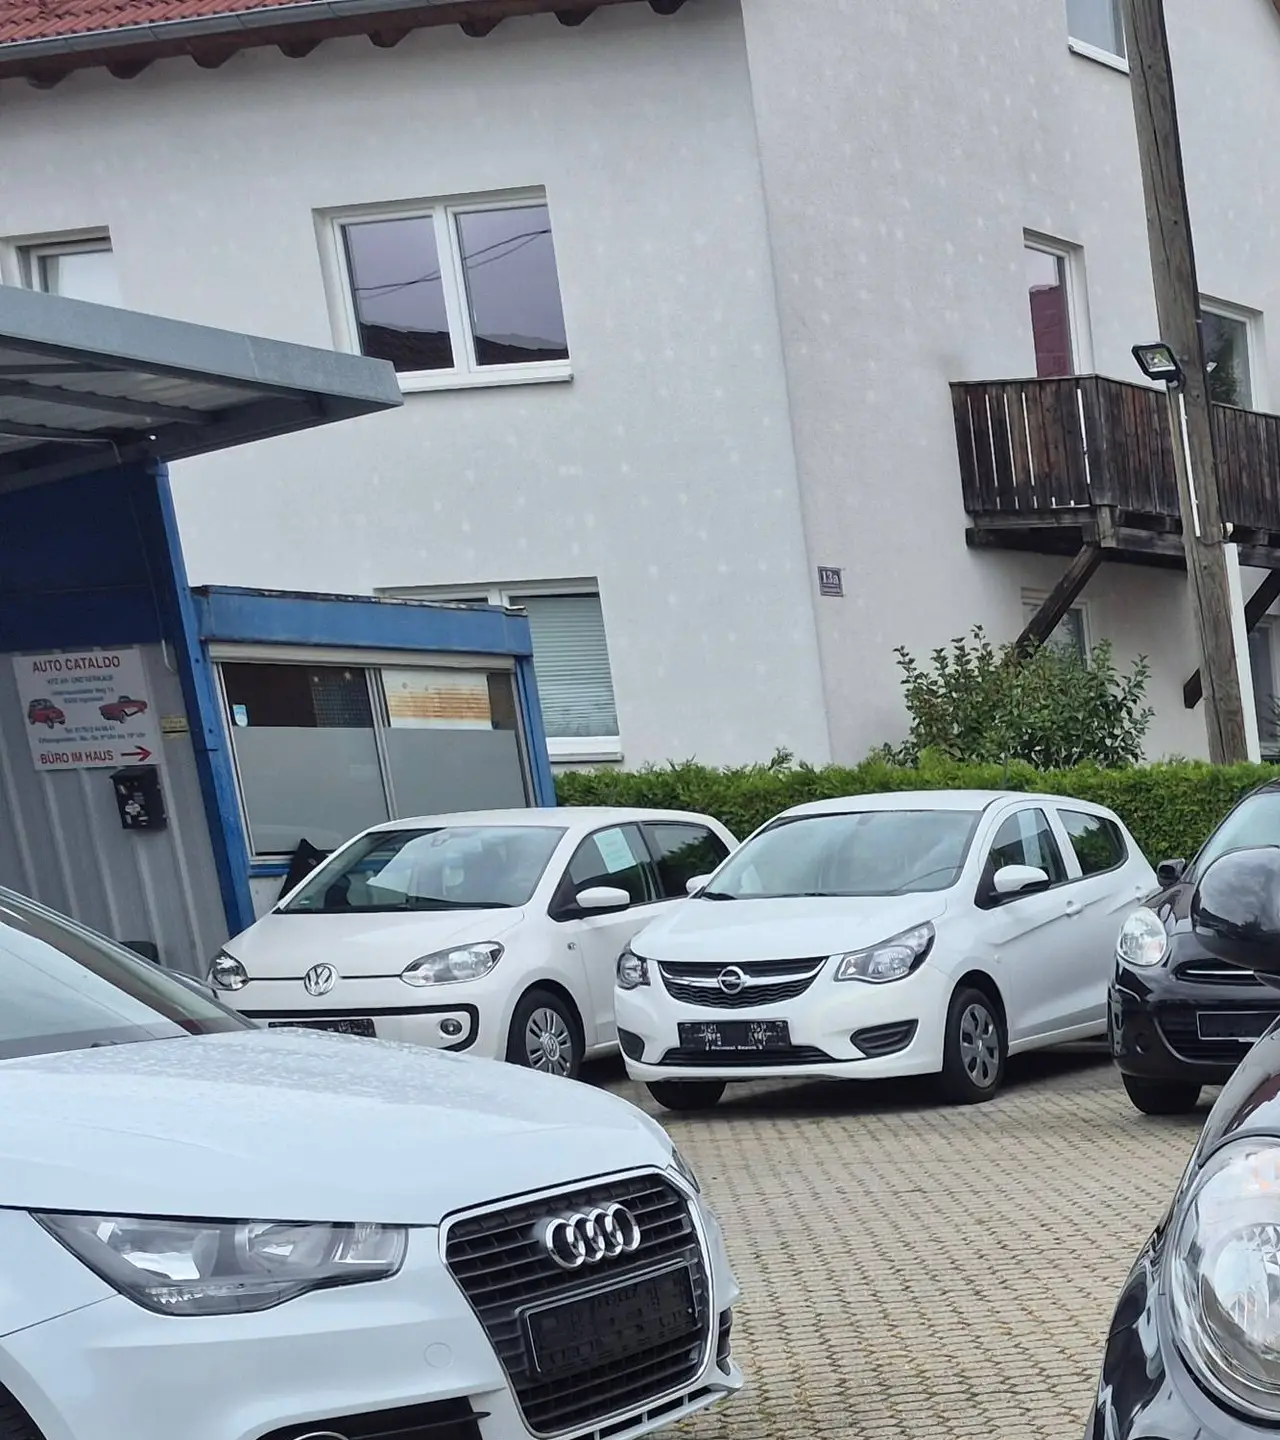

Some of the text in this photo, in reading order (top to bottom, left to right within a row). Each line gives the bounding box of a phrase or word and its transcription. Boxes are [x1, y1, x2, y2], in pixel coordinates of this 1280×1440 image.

[821, 570, 840, 584] 13a
[32, 656, 121, 673] AUTO CATALDO
[39, 750, 114, 764] BÜRO IM HAUS
